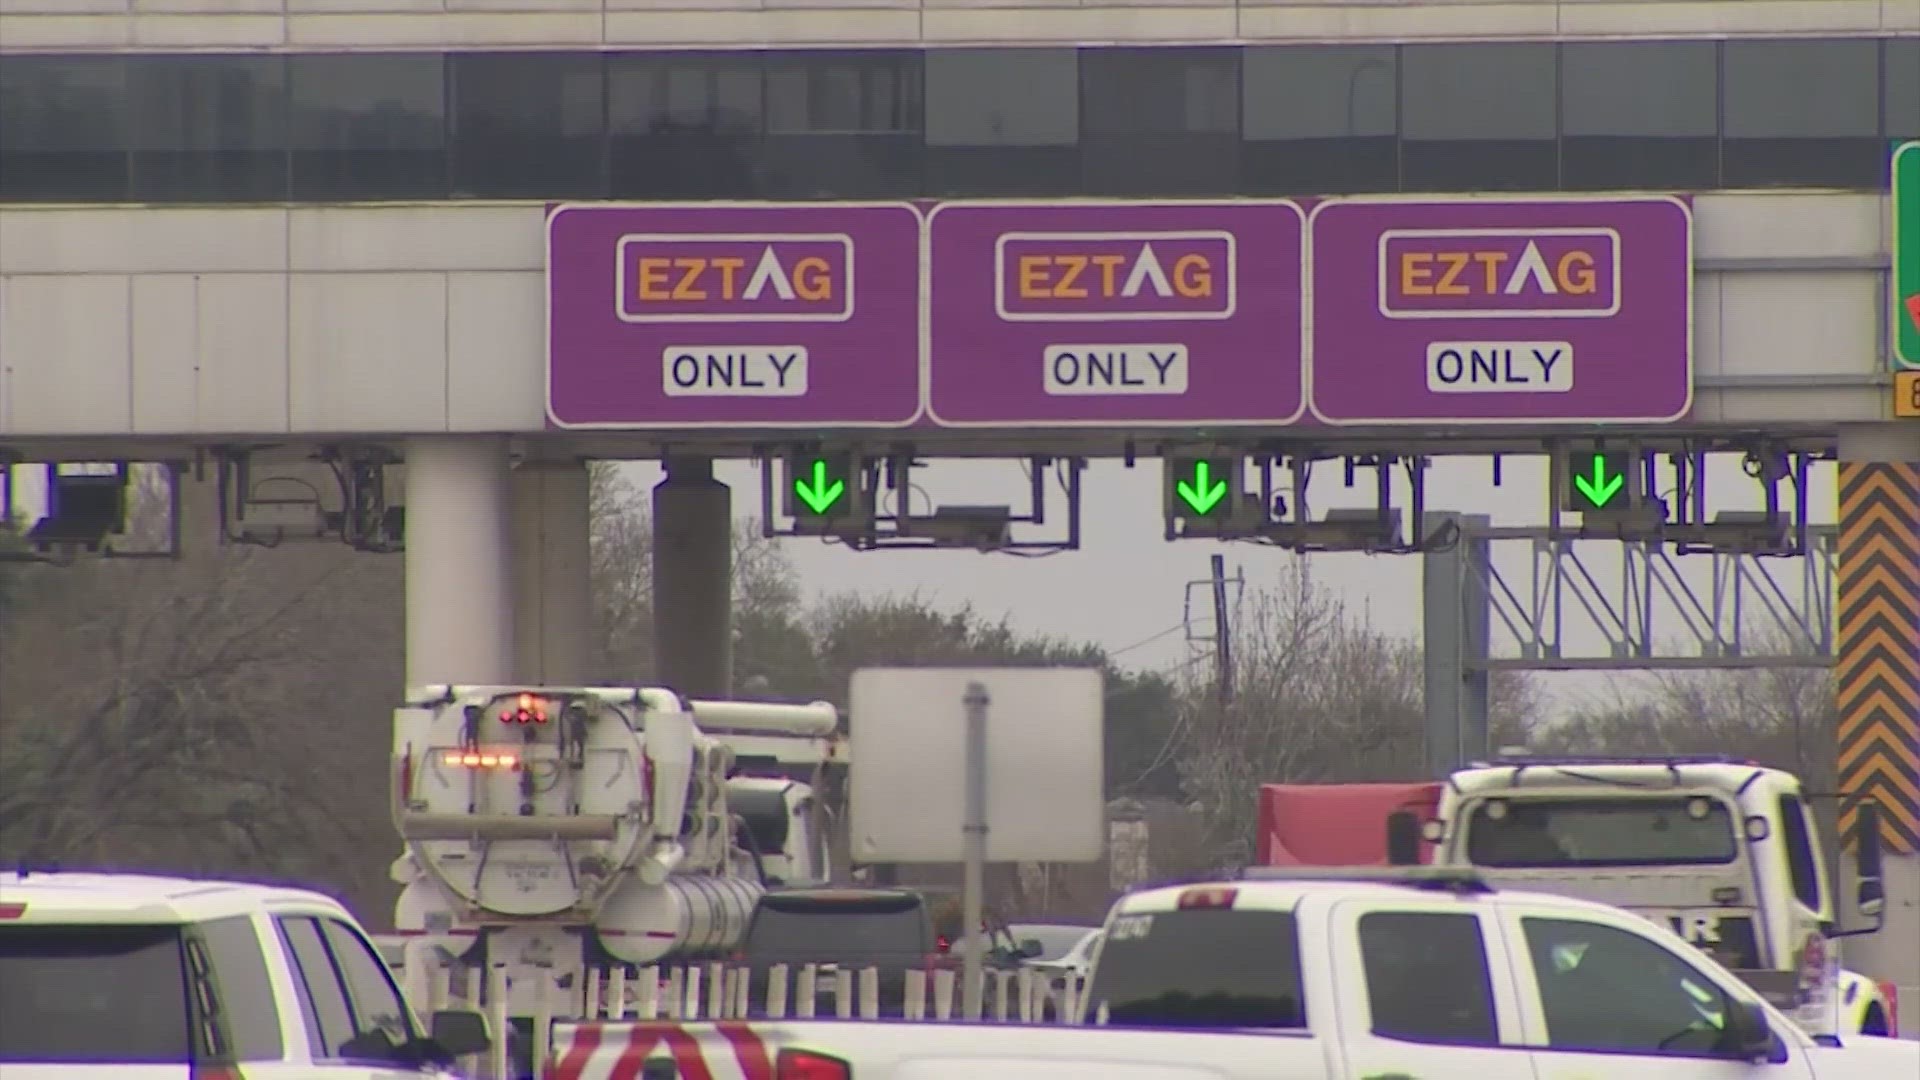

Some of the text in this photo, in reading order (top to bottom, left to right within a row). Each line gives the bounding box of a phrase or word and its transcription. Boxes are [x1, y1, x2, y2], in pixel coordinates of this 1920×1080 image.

[639, 244, 831, 300] EZTAG
[1020, 242, 1212, 298] EZTAG
[1402, 239, 1596, 295] EZTAG
[673, 354, 797, 388] ONLY
[1054, 352, 1177, 386] ONLY
[1436, 349, 1562, 384] ONLY
